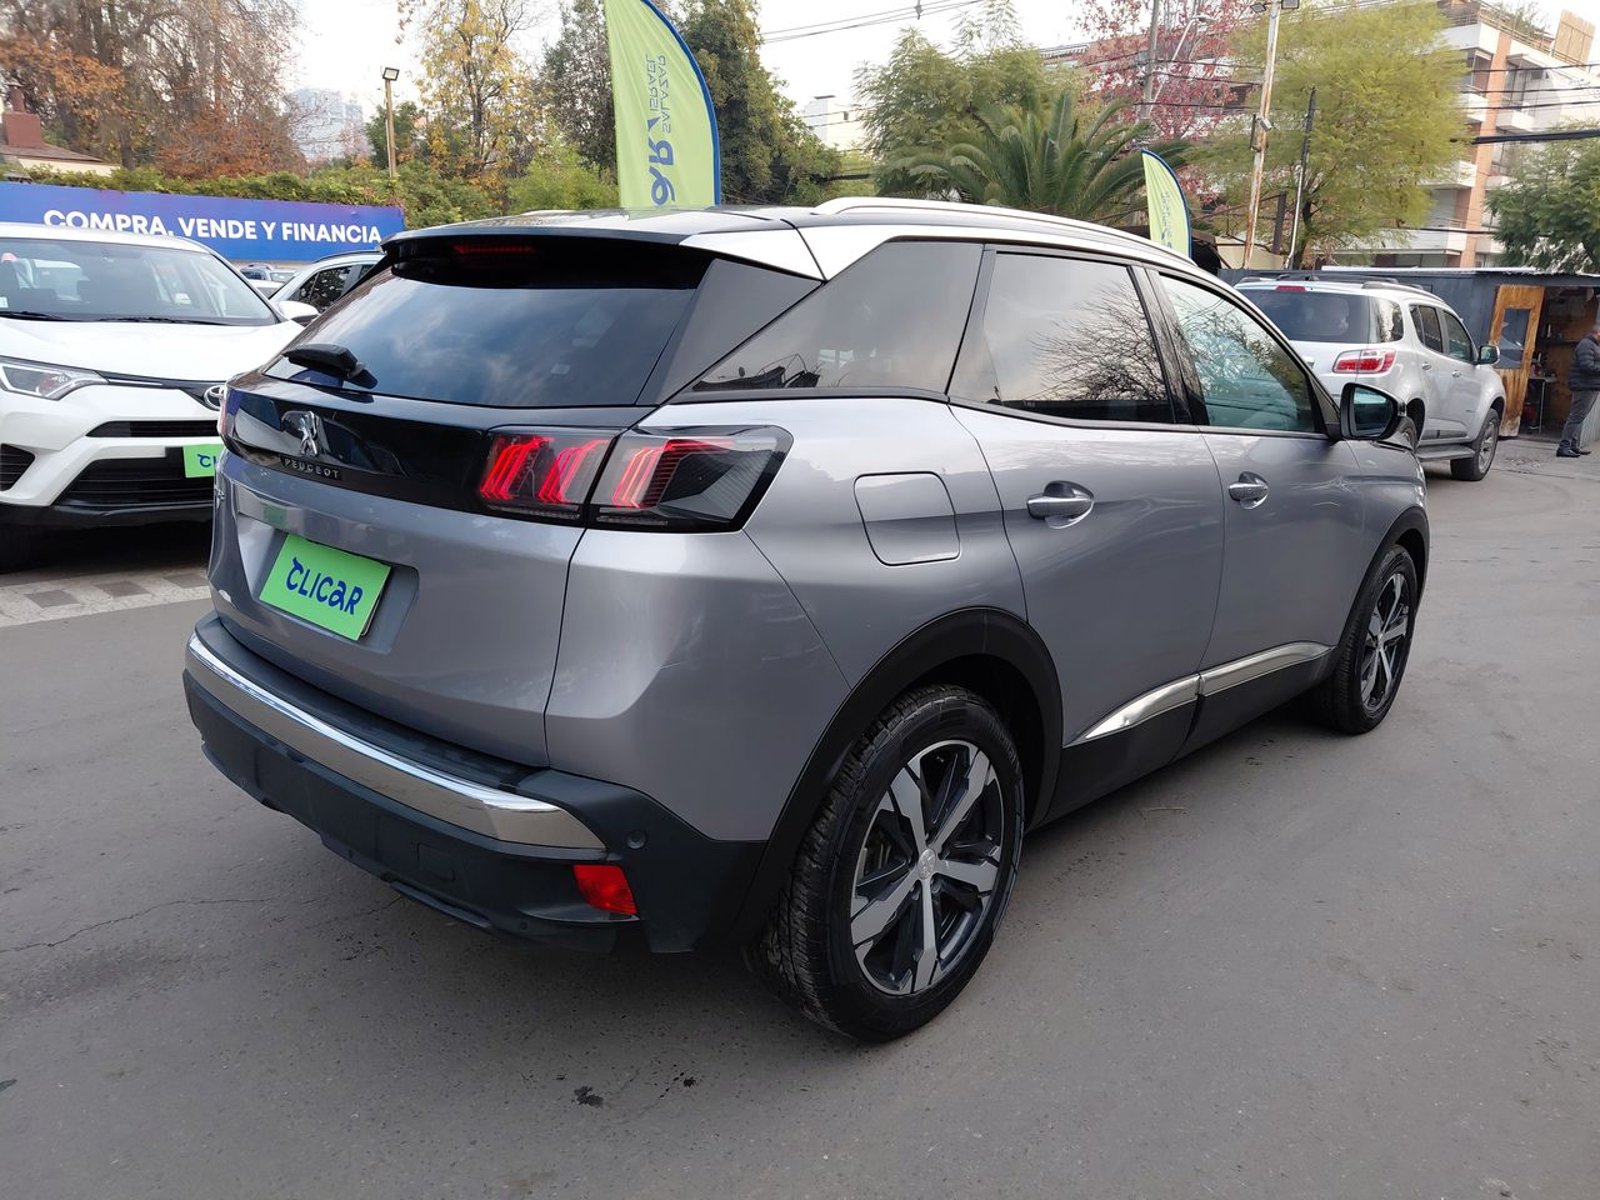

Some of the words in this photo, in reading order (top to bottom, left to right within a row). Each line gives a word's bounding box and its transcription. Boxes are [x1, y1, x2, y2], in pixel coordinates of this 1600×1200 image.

[178, 217, 258, 239] VENDE
[260, 221, 276, 241] Y
[281, 222, 382, 244] FINANCIA
[284, 458, 339, 479] PEUGEOT
